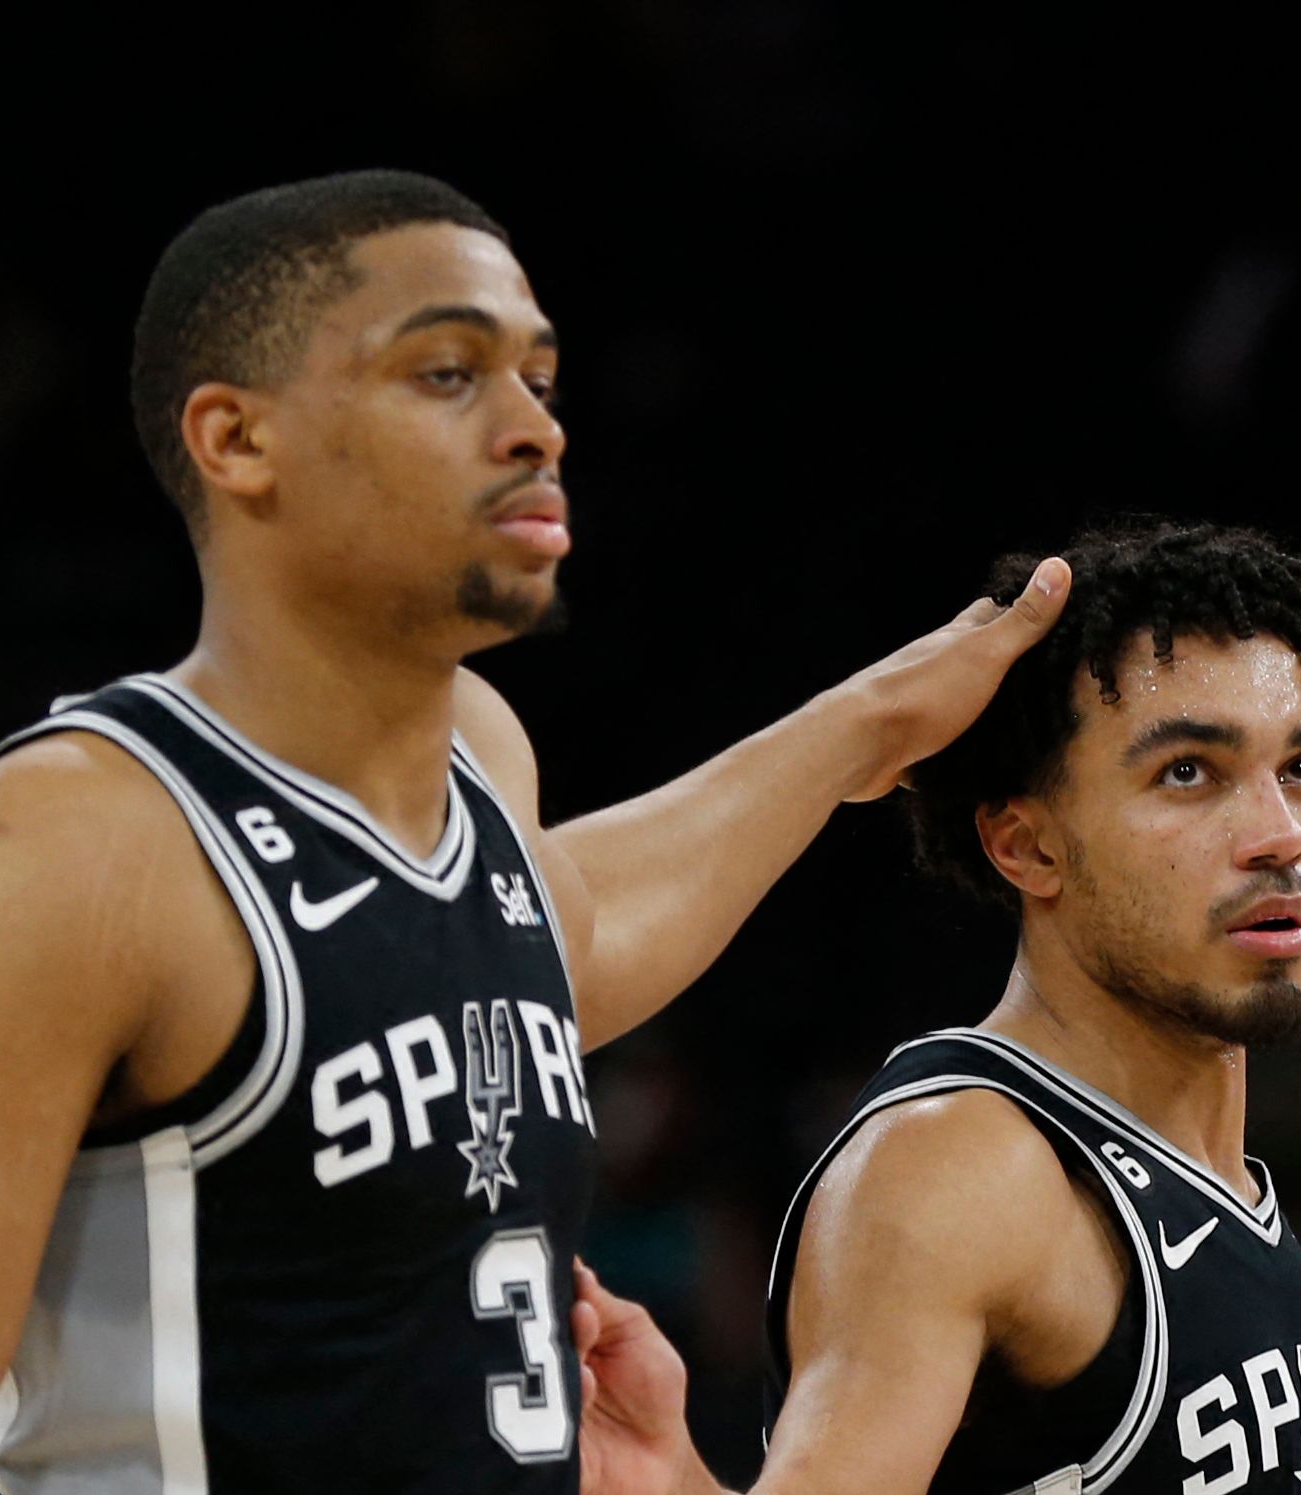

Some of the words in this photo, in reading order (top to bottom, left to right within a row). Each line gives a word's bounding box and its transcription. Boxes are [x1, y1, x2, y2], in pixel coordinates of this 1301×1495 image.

[235, 805, 295, 863] 6
[1101, 1141, 1152, 1190] 6
[469, 1225, 575, 1465] 3
